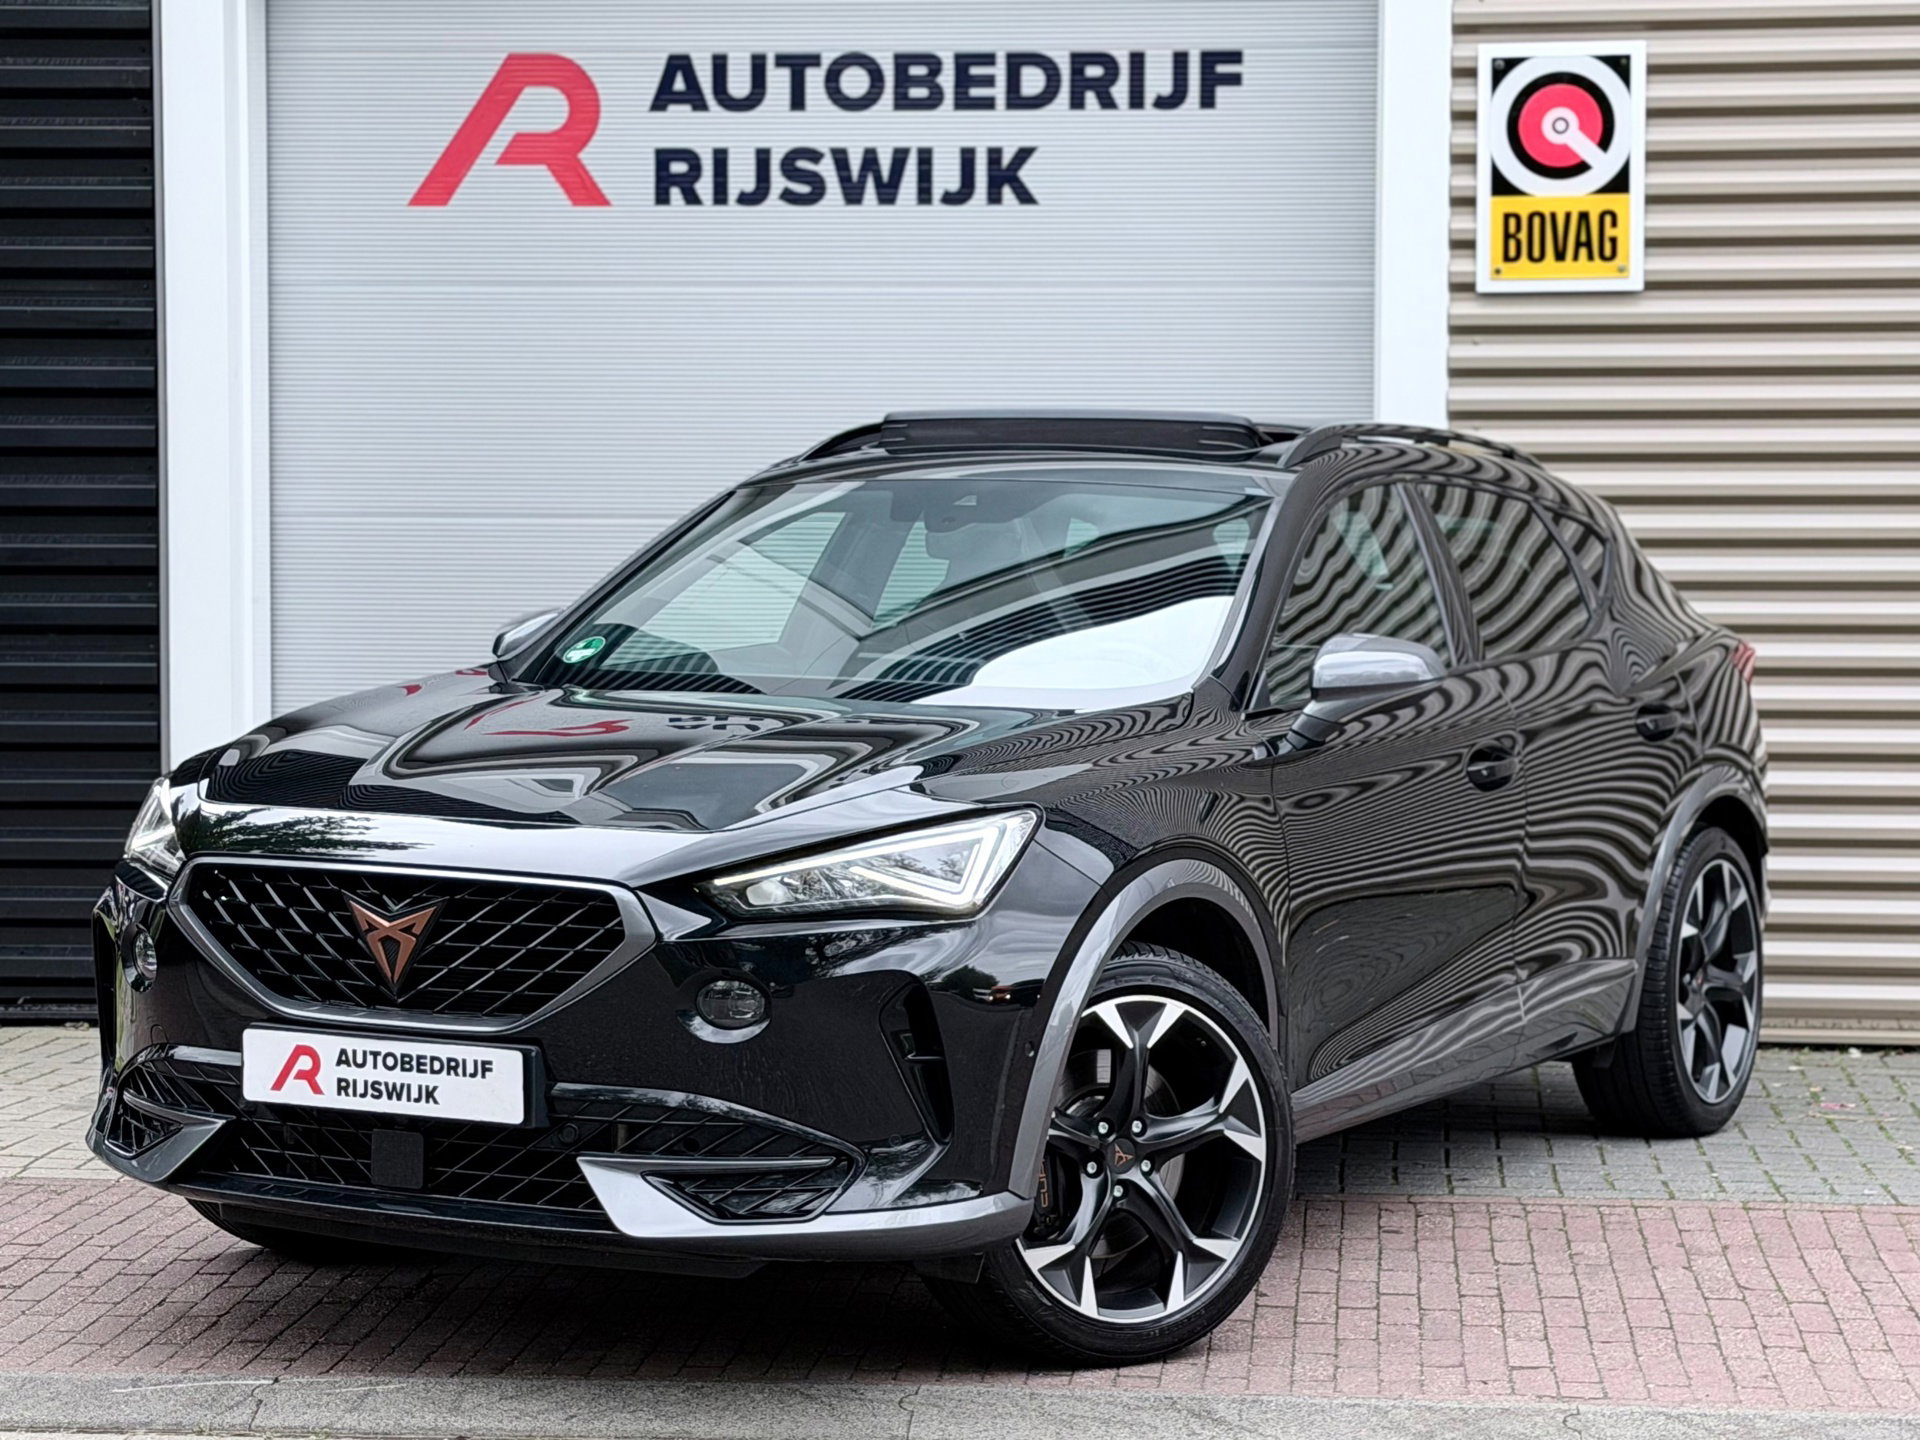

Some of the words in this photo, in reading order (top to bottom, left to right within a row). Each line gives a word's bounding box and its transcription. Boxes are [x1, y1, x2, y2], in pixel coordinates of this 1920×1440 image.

[648, 49, 1244, 112] AUTOBEDRIJF
[653, 146, 1039, 207] RIJSWIJK
[1502, 209, 1618, 263] BOVAG
[335, 1048, 494, 1079] AUTOBEDRIJF
[336, 1077, 440, 1105] RIJSWIJK
